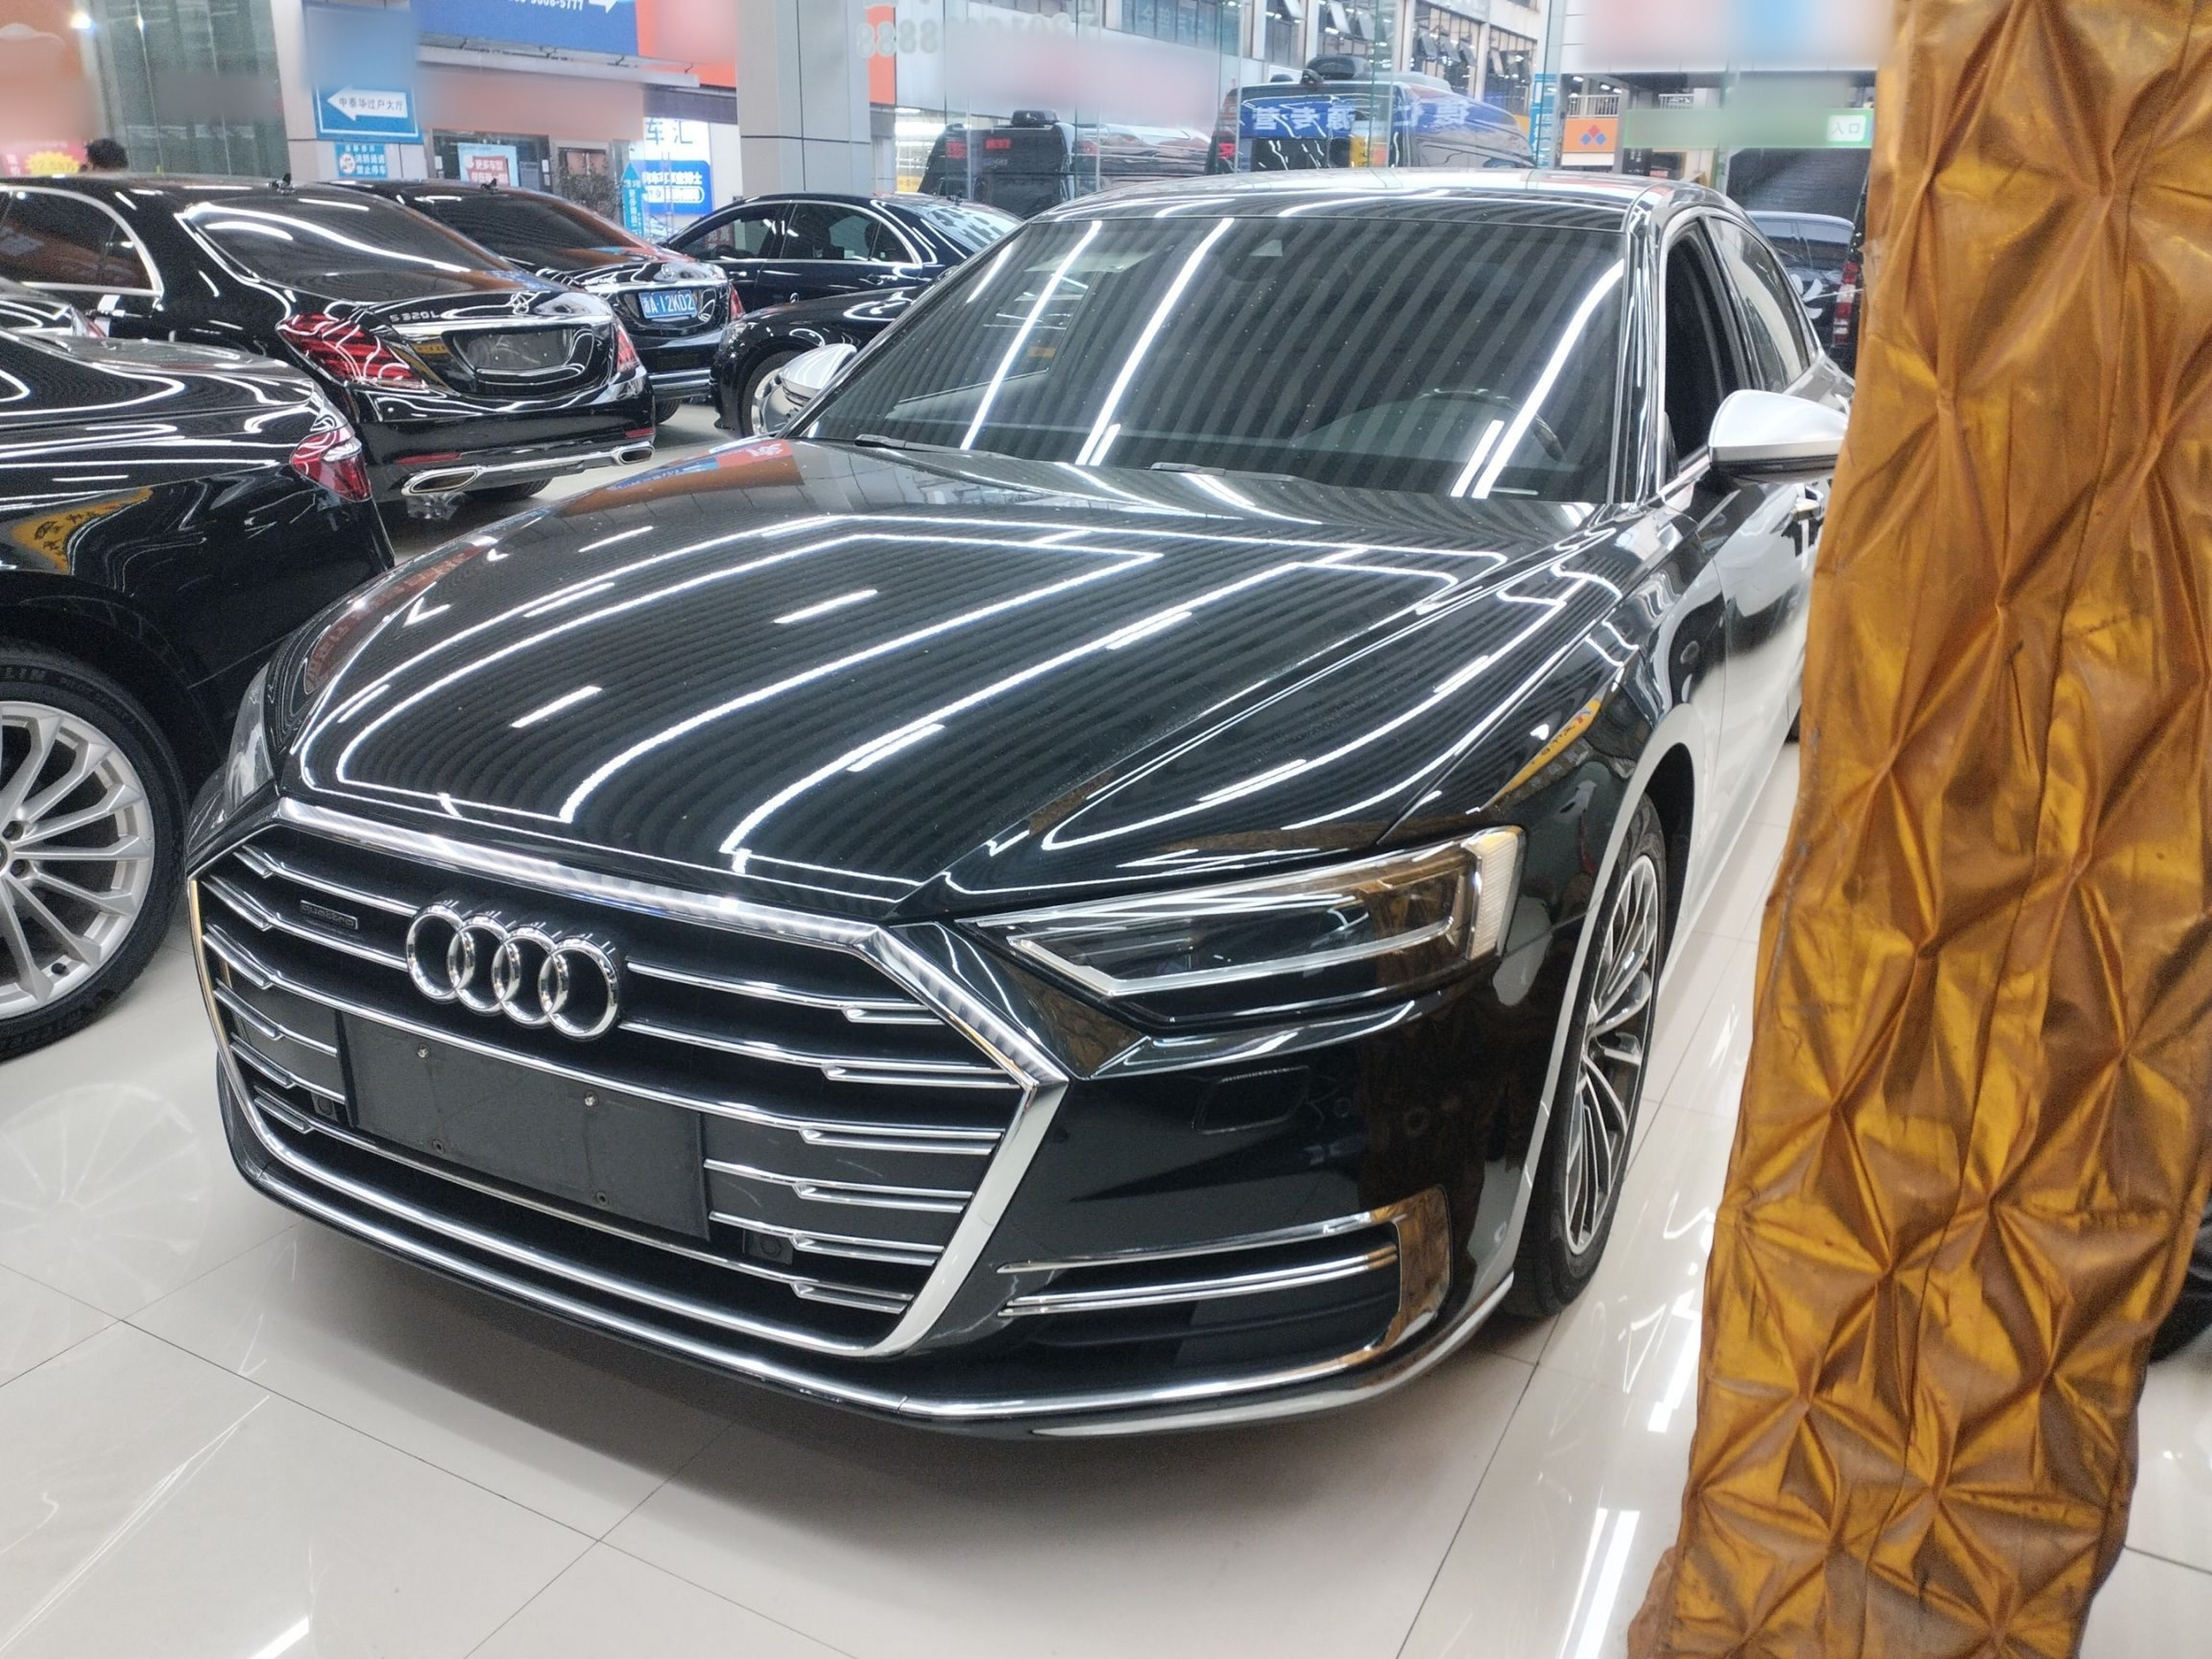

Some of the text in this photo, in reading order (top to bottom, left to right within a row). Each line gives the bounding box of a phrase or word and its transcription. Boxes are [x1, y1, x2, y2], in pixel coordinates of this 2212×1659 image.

[339, 97, 403, 111] 中泰华过户大厅
[1832, 120, 1859, 135] 入口
[301, 905, 354, 927] quattro
